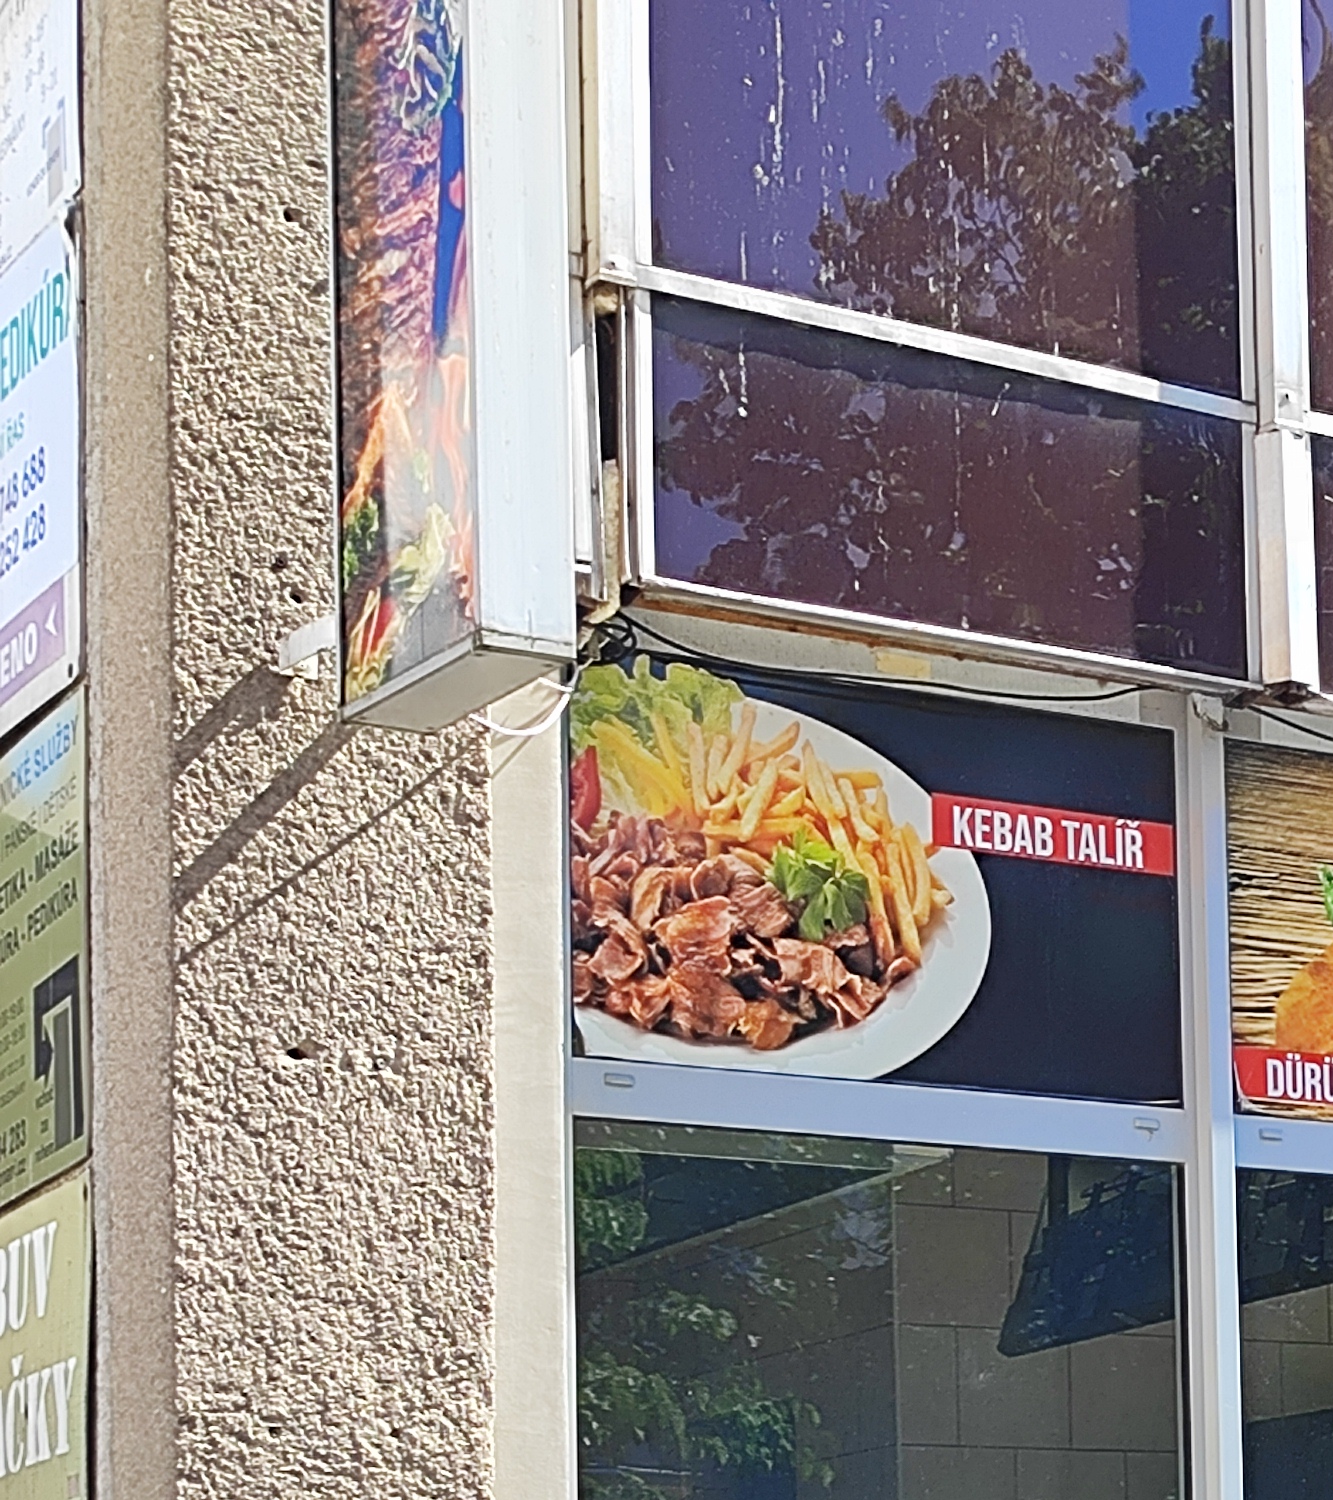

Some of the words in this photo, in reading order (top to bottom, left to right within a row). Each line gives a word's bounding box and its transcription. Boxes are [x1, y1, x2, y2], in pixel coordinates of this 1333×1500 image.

[34, 715, 78, 778] SLUŽBY
[953, 805, 1054, 858] KEBAB
[1061, 818, 1144, 869] TALÍŘ
